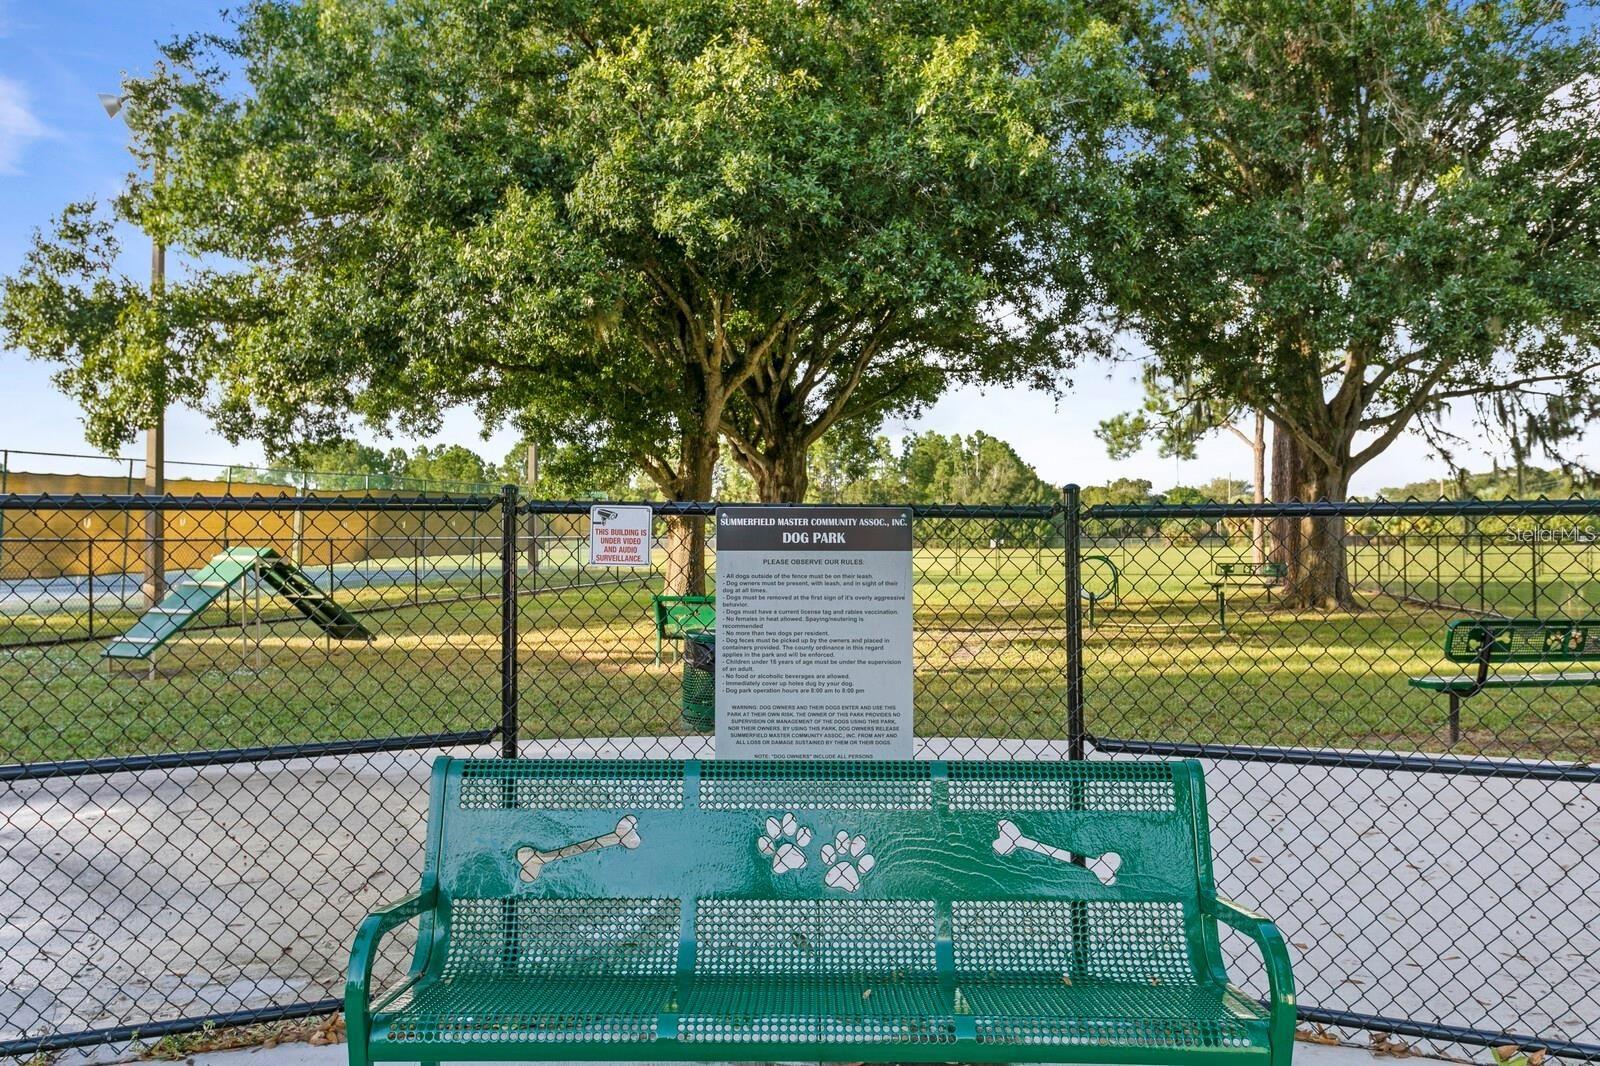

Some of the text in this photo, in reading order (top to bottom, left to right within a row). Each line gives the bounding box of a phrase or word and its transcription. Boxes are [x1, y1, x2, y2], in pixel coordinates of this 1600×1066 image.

[811, 518, 857, 526] COMMUNITY
[859, 518, 890, 527] ASSOC.,
[782, 532, 846, 543] DOG PARK
